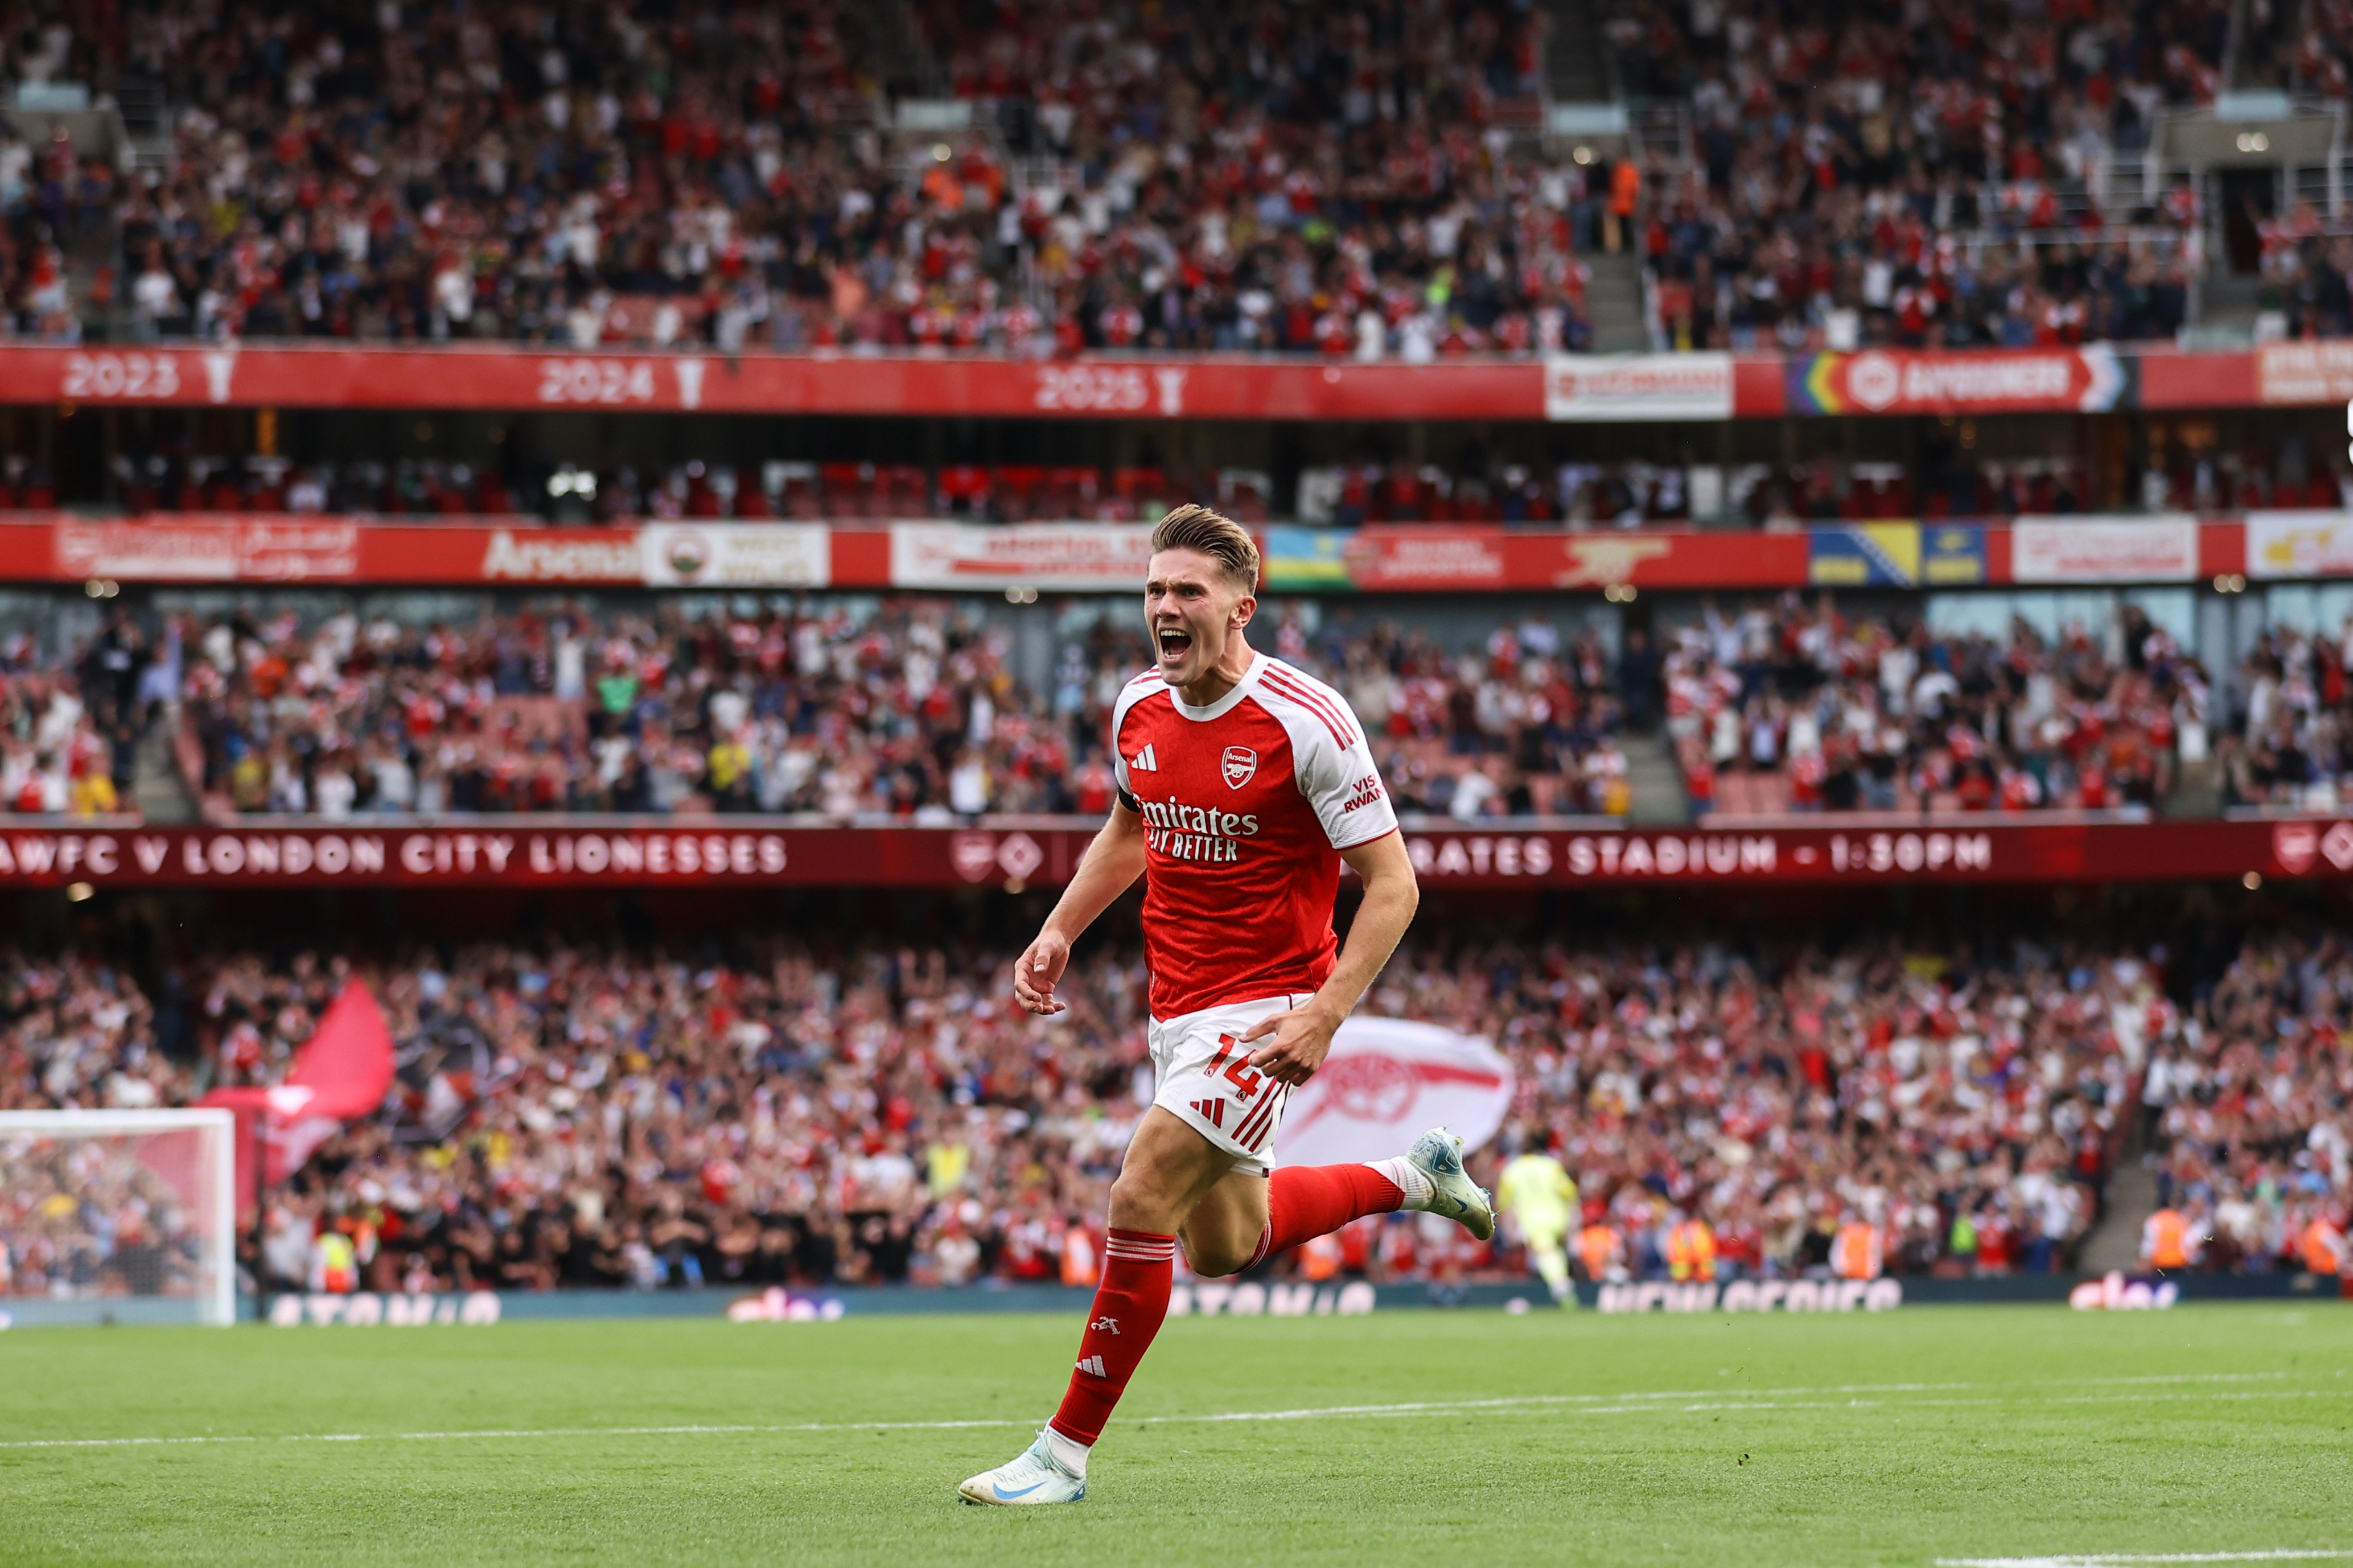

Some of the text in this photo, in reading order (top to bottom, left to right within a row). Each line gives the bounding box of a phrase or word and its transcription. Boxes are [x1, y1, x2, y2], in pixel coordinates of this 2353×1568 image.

[63, 353, 180, 398] 2023
[538, 359, 655, 403] 2024
[1227, 752, 1252, 763] Arsenal
[1343, 787, 1384, 814] RWAN
[1352, 773, 1377, 793] VIS
[132, 834, 168, 875] V
[183, 834, 386, 875] LONDON
[400, 834, 515, 874] CITY
[529, 834, 787, 875] LIONESSES
[1172, 833, 1238, 862] BETTER
[1567, 836, 1778, 875] STADIUM
[1203, 1032, 1262, 1102] 14
